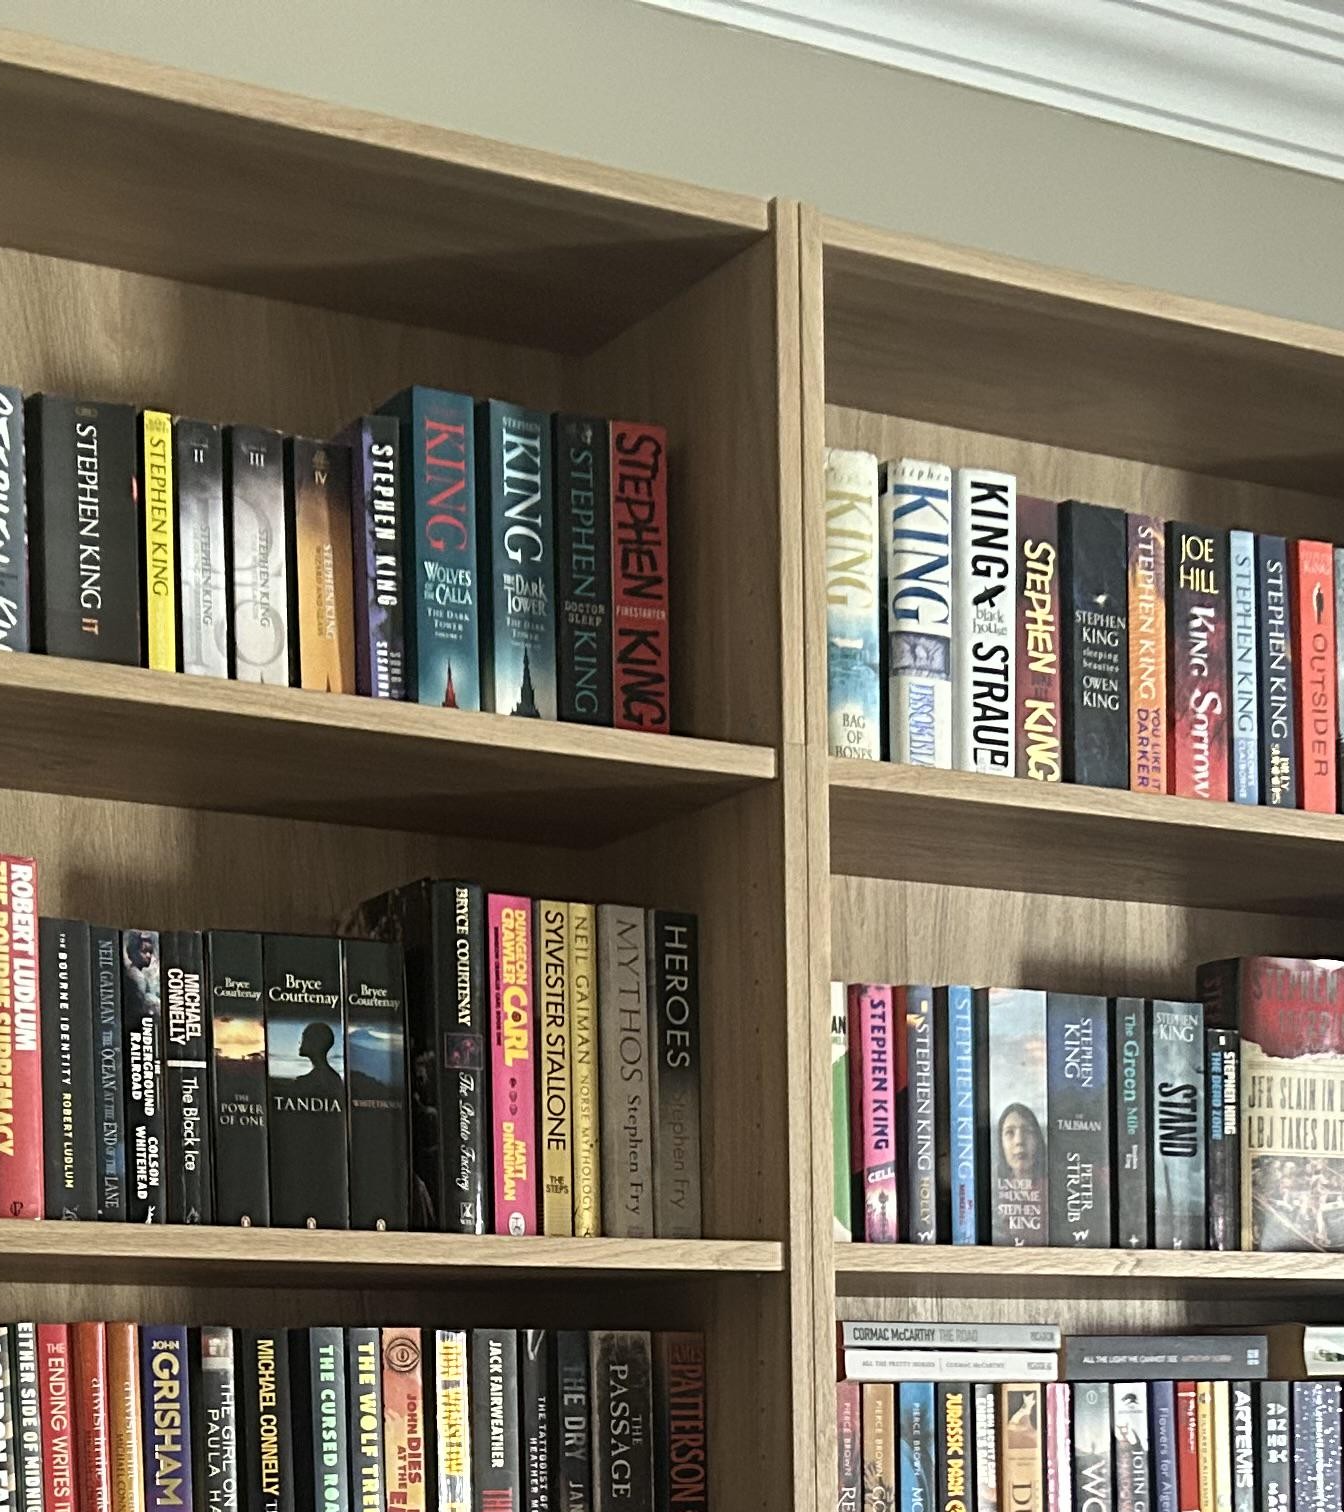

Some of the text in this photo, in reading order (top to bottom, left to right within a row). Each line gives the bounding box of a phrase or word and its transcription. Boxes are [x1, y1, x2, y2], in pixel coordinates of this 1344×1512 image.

[150, 438, 168, 596] STEPHEN KING
[372, 444, 397, 606] STEPHEN KING
[425, 417, 467, 552] KING
[502, 428, 543, 564] KING
[970, 481, 1009, 578] KING
[570, 451, 597, 714] STEPHEN KING
[616, 432, 667, 727] STEPHEN KING
[893, 484, 949, 627] KING
[1181, 536, 1214, 563] JOE
[1181, 567, 1218, 594] HILL
[565, 601, 605, 614] DOCTOR
[568, 613, 602, 626] SLEEP
[616, 605, 665, 620] FIRESTARTER
[1024, 540, 1060, 781] STEPHEN KING
[1267, 560, 1287, 739] STEPHEN KING
[1083, 678, 1118, 692] OWEN
[1312, 634, 1327, 777] OUTSIDER
[11, 864, 36, 1050] ROBERT LUDLUM
[168, 968, 186, 1046] CONNELLY
[184, 974, 200, 1039] MICHAEL
[665, 925, 690, 1067] HEROES
[58, 952, 73, 1188] BOURNE IDENTITY ROBERT LUDLUM
[545, 912, 566, 1152] SYLVESTER STALLONE
[871, 1000, 888, 1150] STEPHEN KING
[1058, 1120, 1101, 1131] TALISMAN
[1159, 1082, 1197, 1157] STAND
[1249, 1075, 1273, 1108] JFK
[1280, 1078, 1315, 1111] SLAIN
[1322, 1080, 1334, 1112] IN
[1249, 1116, 1272, 1148] LBJ
[1281, 1117, 1317, 1150] TAKES
[47, 1357, 67, 1429] ENDING
[319, 1345, 334, 1382] THE
[489, 1340, 503, 1468] JACK FAIRWEATHER
[50, 1435, 69, 1499] WRITES
[152, 1354, 182, 1505] GRISHAM
[207, 1409, 219, 1478] PAULA
[320, 1393, 337, 1467] CURSED
[610, 1364, 630, 1498] PASSAGE
[670, 1363, 704, 1502] PATTERSON
[1235, 1391, 1252, 1488] ARTEMIS
